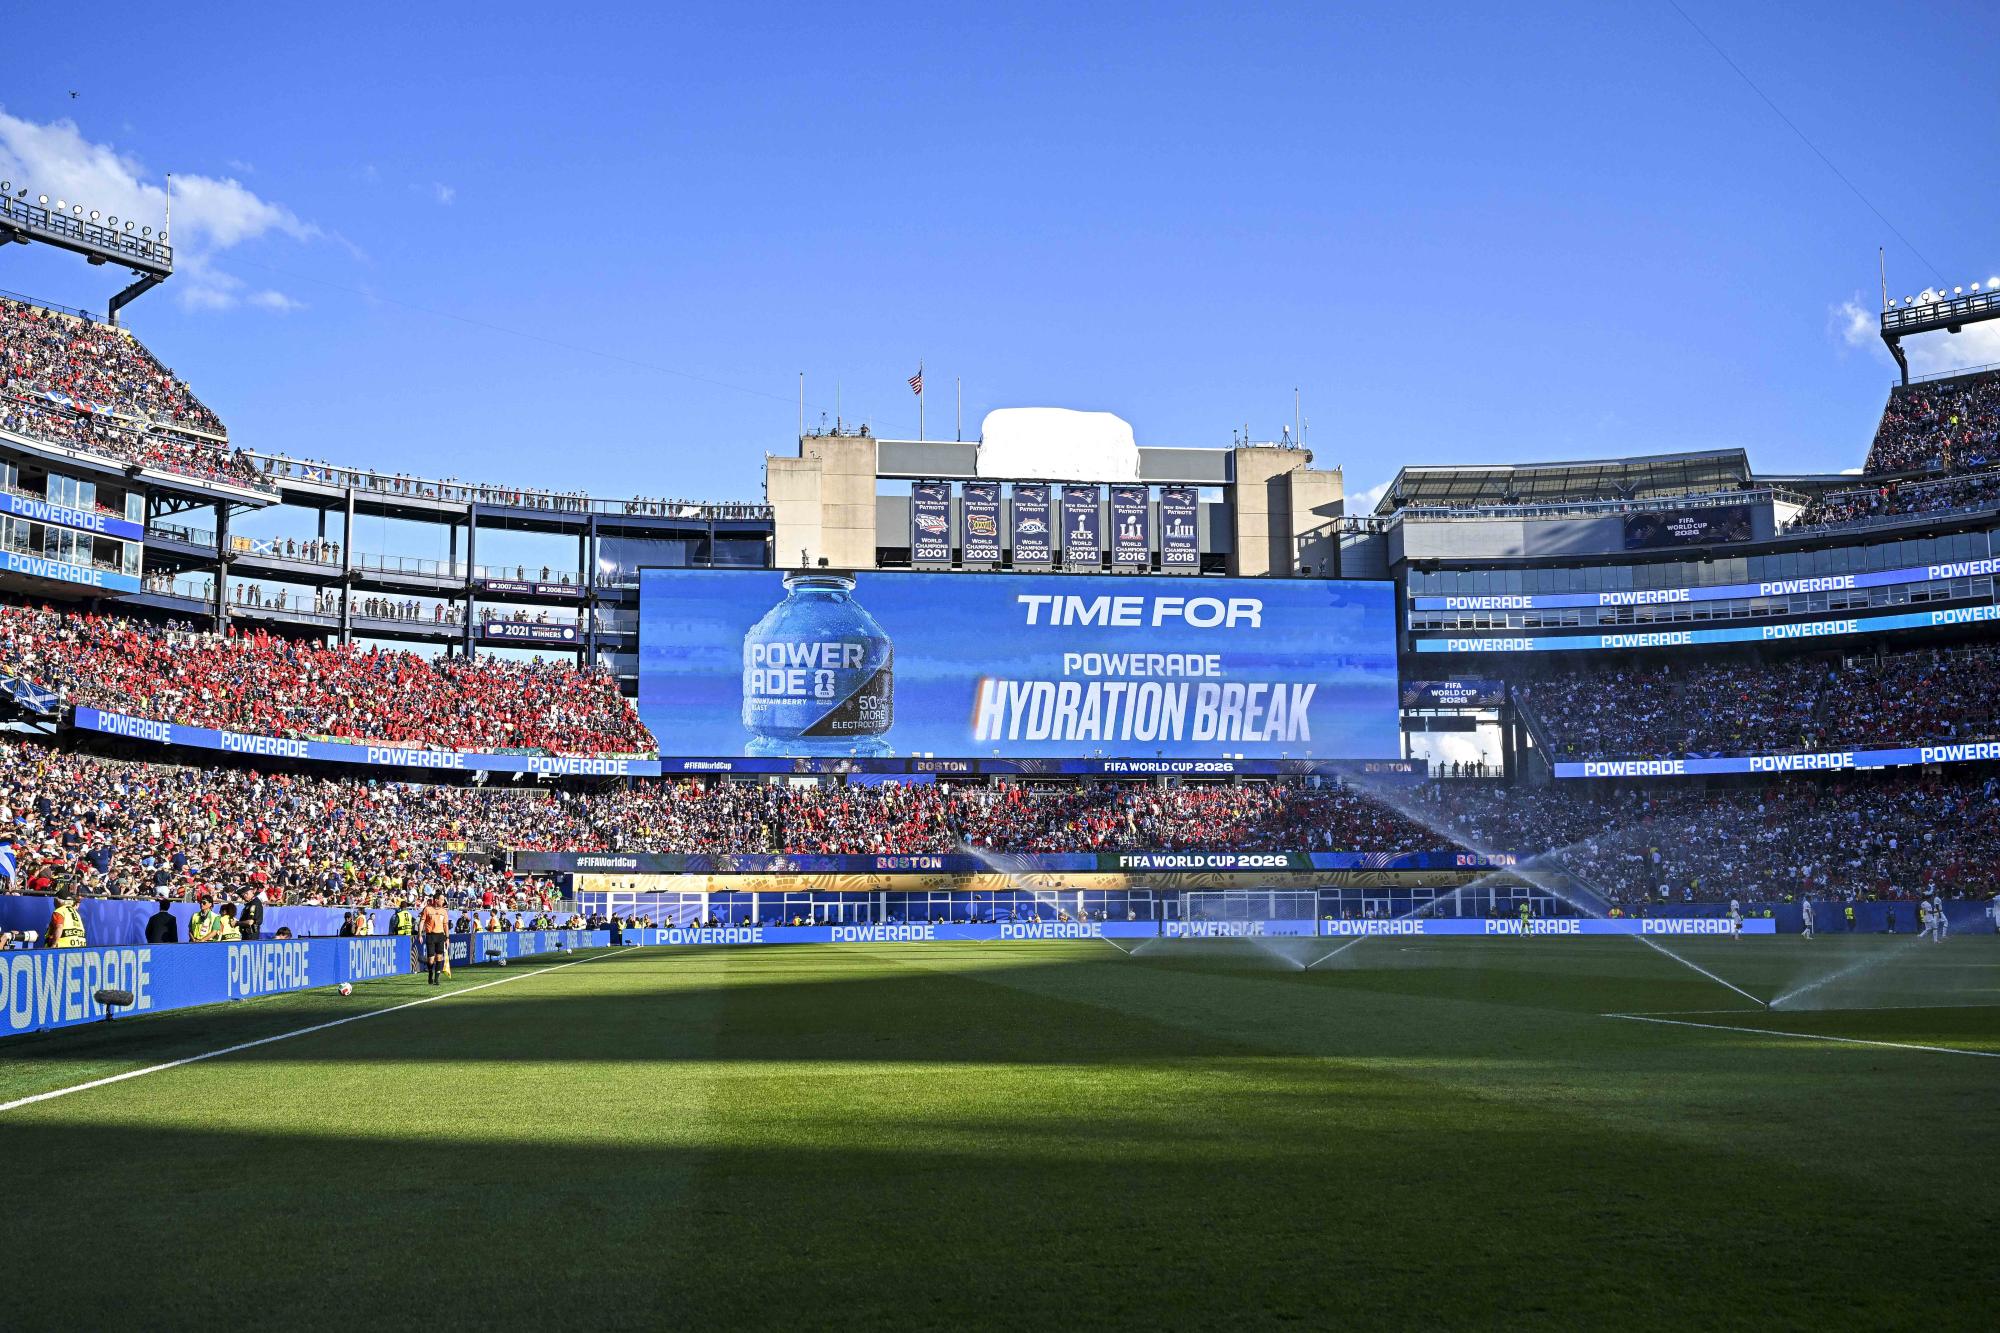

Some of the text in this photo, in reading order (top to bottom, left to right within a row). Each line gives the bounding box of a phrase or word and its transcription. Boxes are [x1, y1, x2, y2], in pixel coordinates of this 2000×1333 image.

[11, 497, 105, 532] POWERADE
[8, 554, 102, 585] POWERADE
[1447, 596, 1532, 609] POWERADE
[1600, 589, 1689, 605] POWERADE
[1760, 575, 1855, 596] POWERADE
[1018, 595, 1263, 628] TIME FOR
[506, 625, 528, 636] 2021
[1448, 638, 1533, 651] POWERADE
[1602, 632, 1692, 648] POWERADE
[1763, 619, 1858, 639] POWERADE
[752, 643, 864, 668] POWER
[1064, 653, 1221, 676] POWERADE
[752, 670, 806, 694] ADE
[859, 710, 885, 720] MORE
[975, 680, 1316, 742] HYDRATION BREAK
[99, 710, 628, 775] POWERADE POWERADE POWERADE POWERADE
[684, 762, 966, 771] #FIFAWorldCup BOSTON
[1105, 762, 1233, 772] FIFA WORLD CUP 2026
[1366, 763, 1412, 772] BOSTON
[1585, 760, 1684, 776] POWERADE
[1750, 752, 1854, 772] POWERADE
[577, 857, 942, 869] #FIFAWorldCup BOSTON
[1120, 856, 1288, 867] FIFA WORLD CUP 2026
[1457, 855, 1516, 865] BOSTON
[656, 927, 763, 944] POWERADE
[832, 925, 934, 941] POWERADE
[1001, 922, 1102, 939] POWERADE
[1167, 921, 1264, 937] POWERADE
[1328, 920, 1424, 935] POWERADE
[1642, 919, 1742, 933] POWERAD
[228, 942, 309, 996] POWERADE
[350, 939, 396, 980] POWERADE
